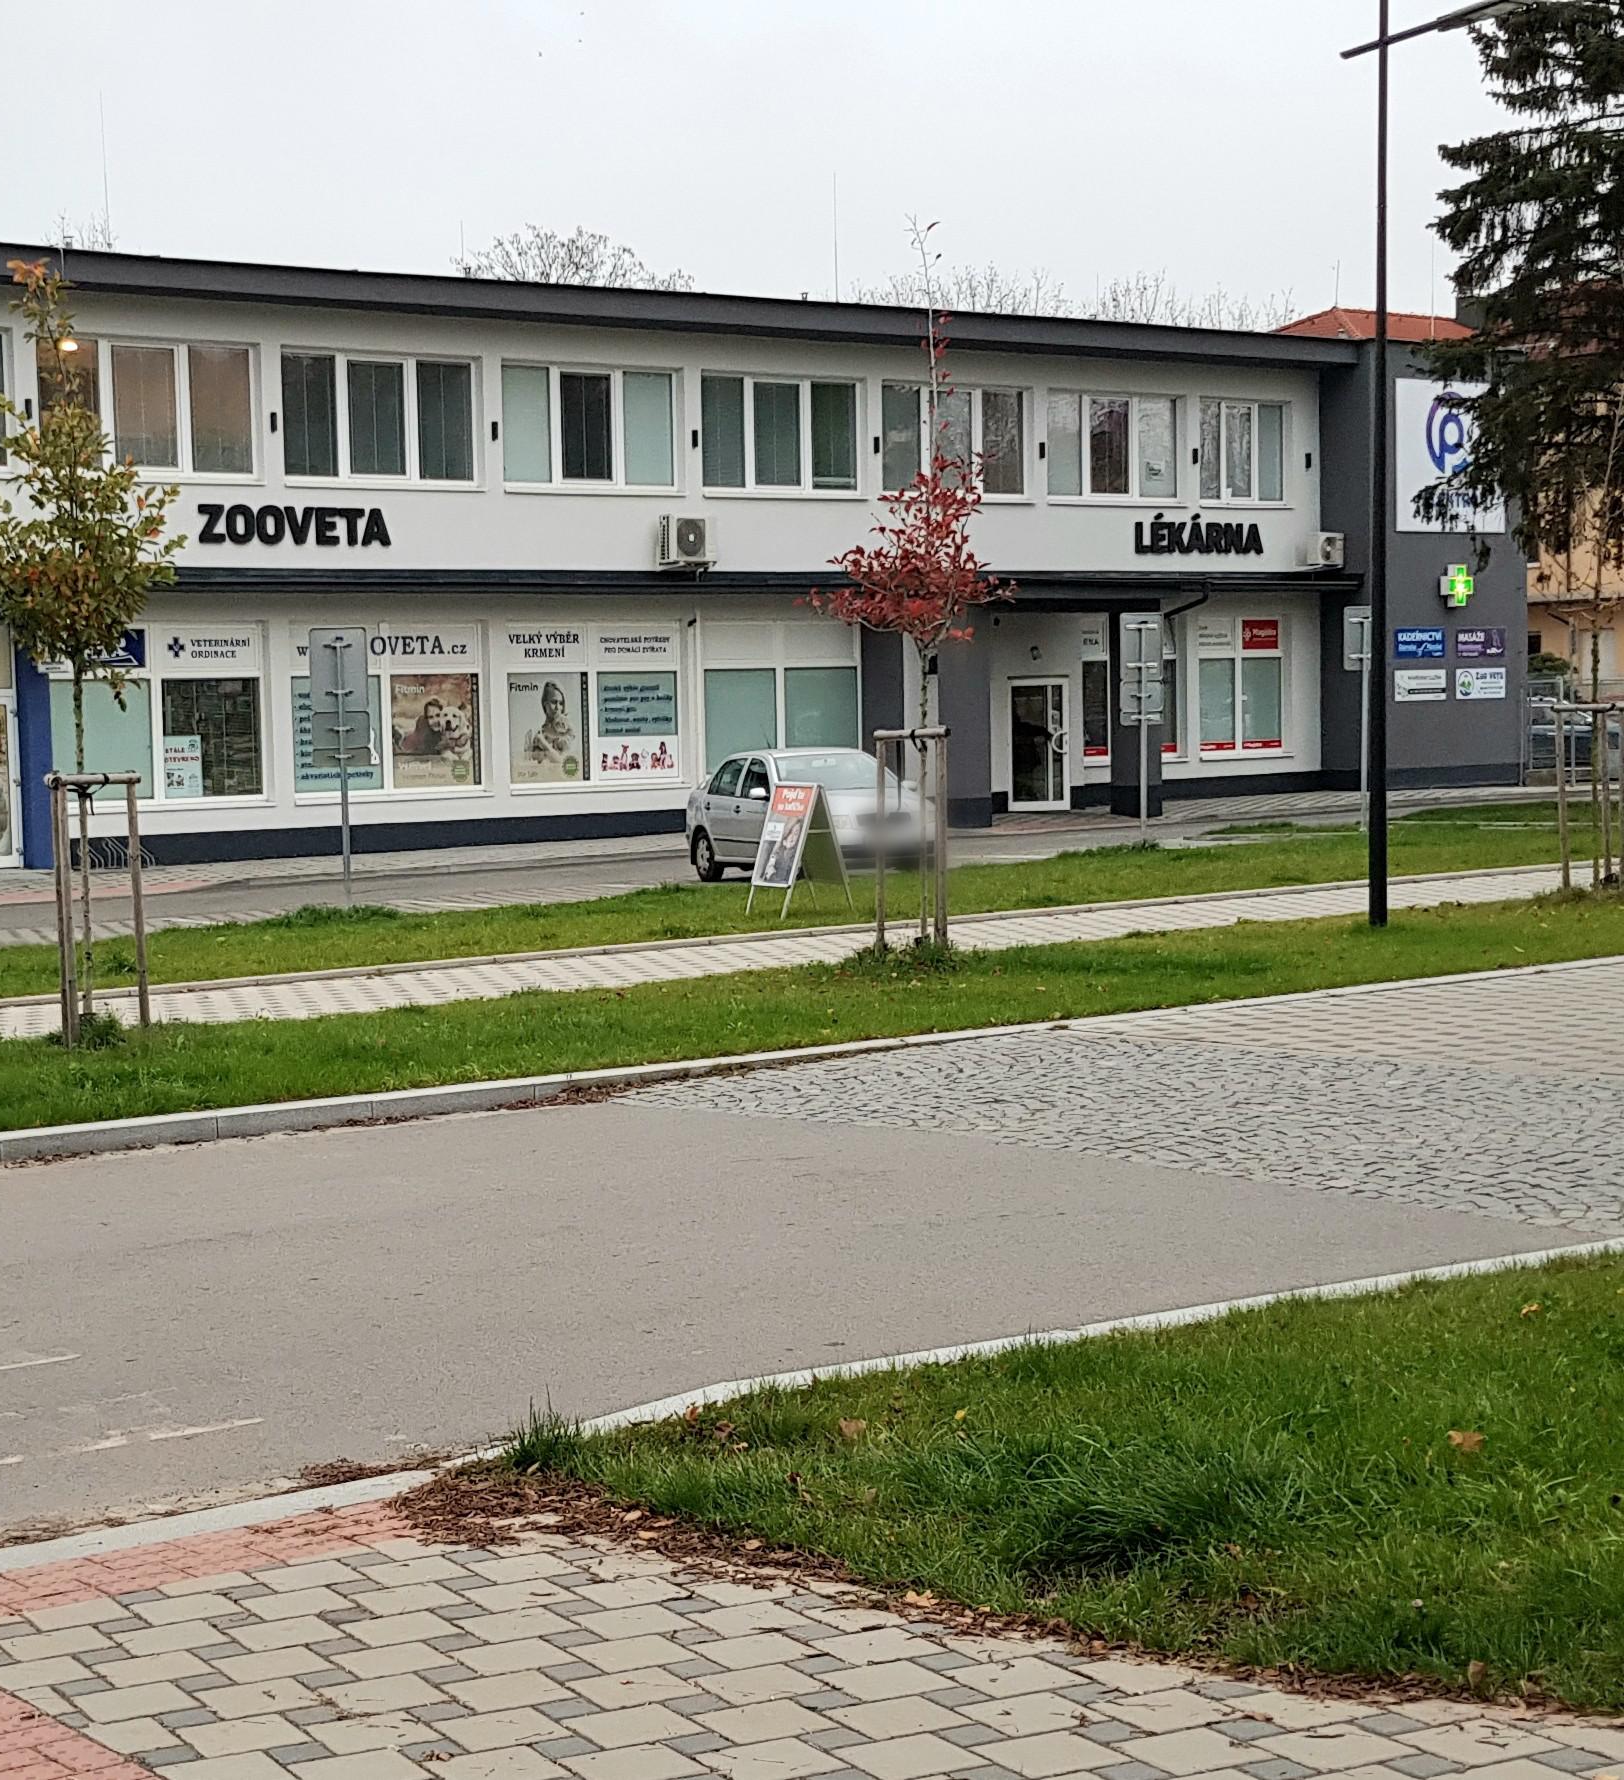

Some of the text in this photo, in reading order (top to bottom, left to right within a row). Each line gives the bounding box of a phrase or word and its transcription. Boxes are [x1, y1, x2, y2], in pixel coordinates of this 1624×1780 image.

[197, 503, 392, 547] ZOOVETA
[1134, 512, 1264, 555] LÉKÁRNA
[190, 635, 251, 649] VETERINÁRNÍ
[508, 630, 580, 645] VELKÝ VÝBĚR
[190, 649, 237, 659] ORDINACE
[524, 645, 566, 659] KRMENÍ
[509, 682, 539, 692] Fitmin
